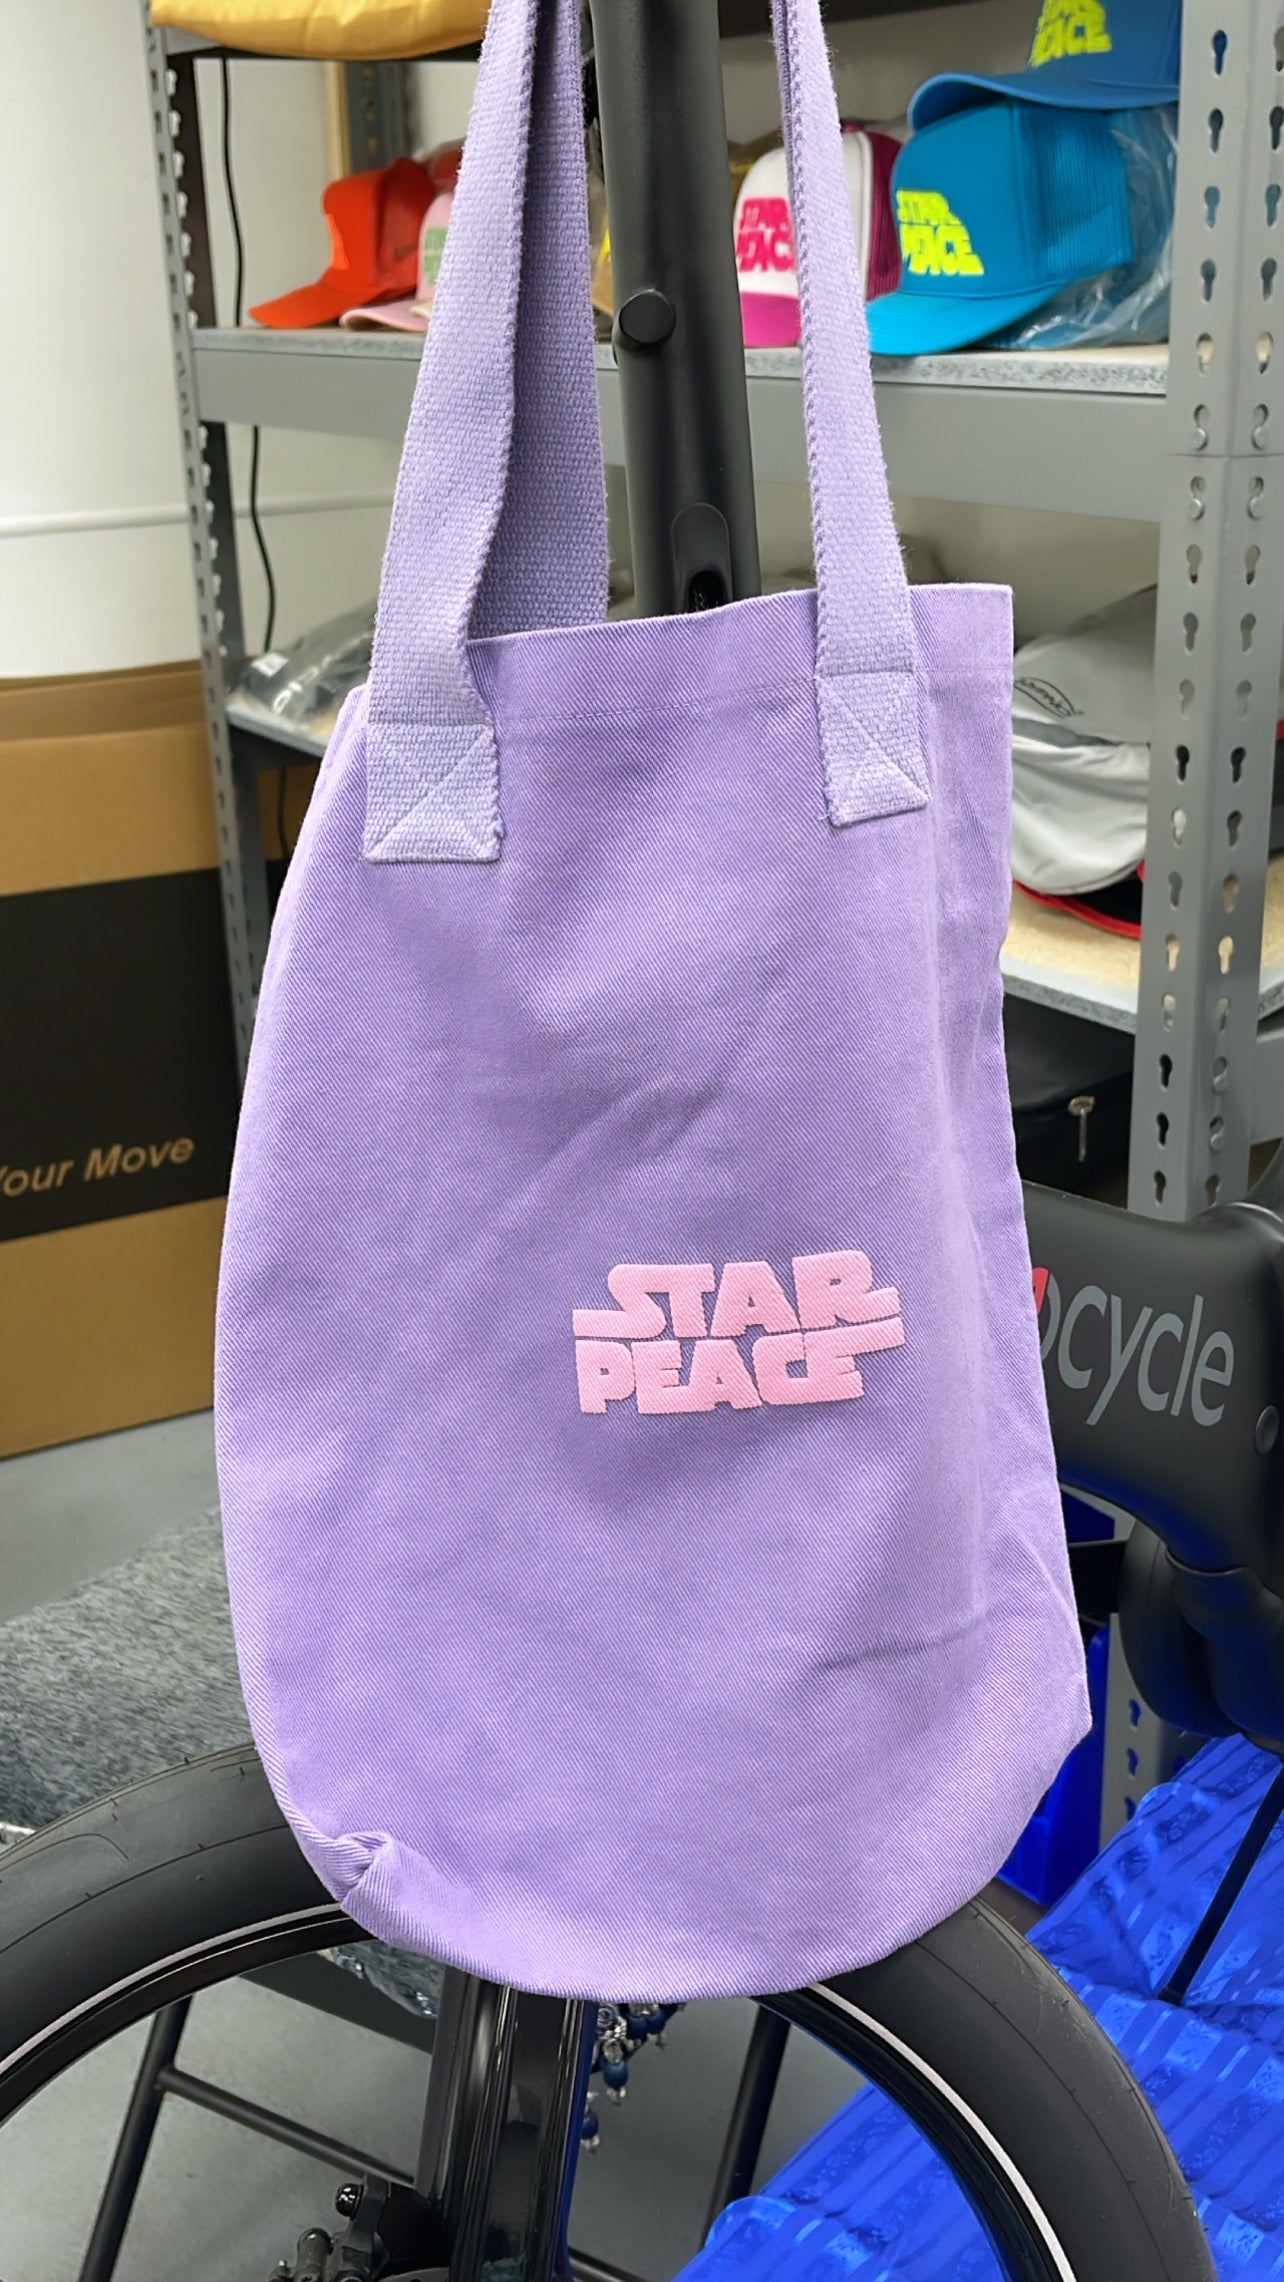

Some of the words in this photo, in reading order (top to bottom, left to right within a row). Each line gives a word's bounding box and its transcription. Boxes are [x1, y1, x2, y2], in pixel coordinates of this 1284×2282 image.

[84, 1137, 195, 1182] Move
[572, 1249, 902, 1339] STAR
[575, 1316, 906, 1414] PEACE
